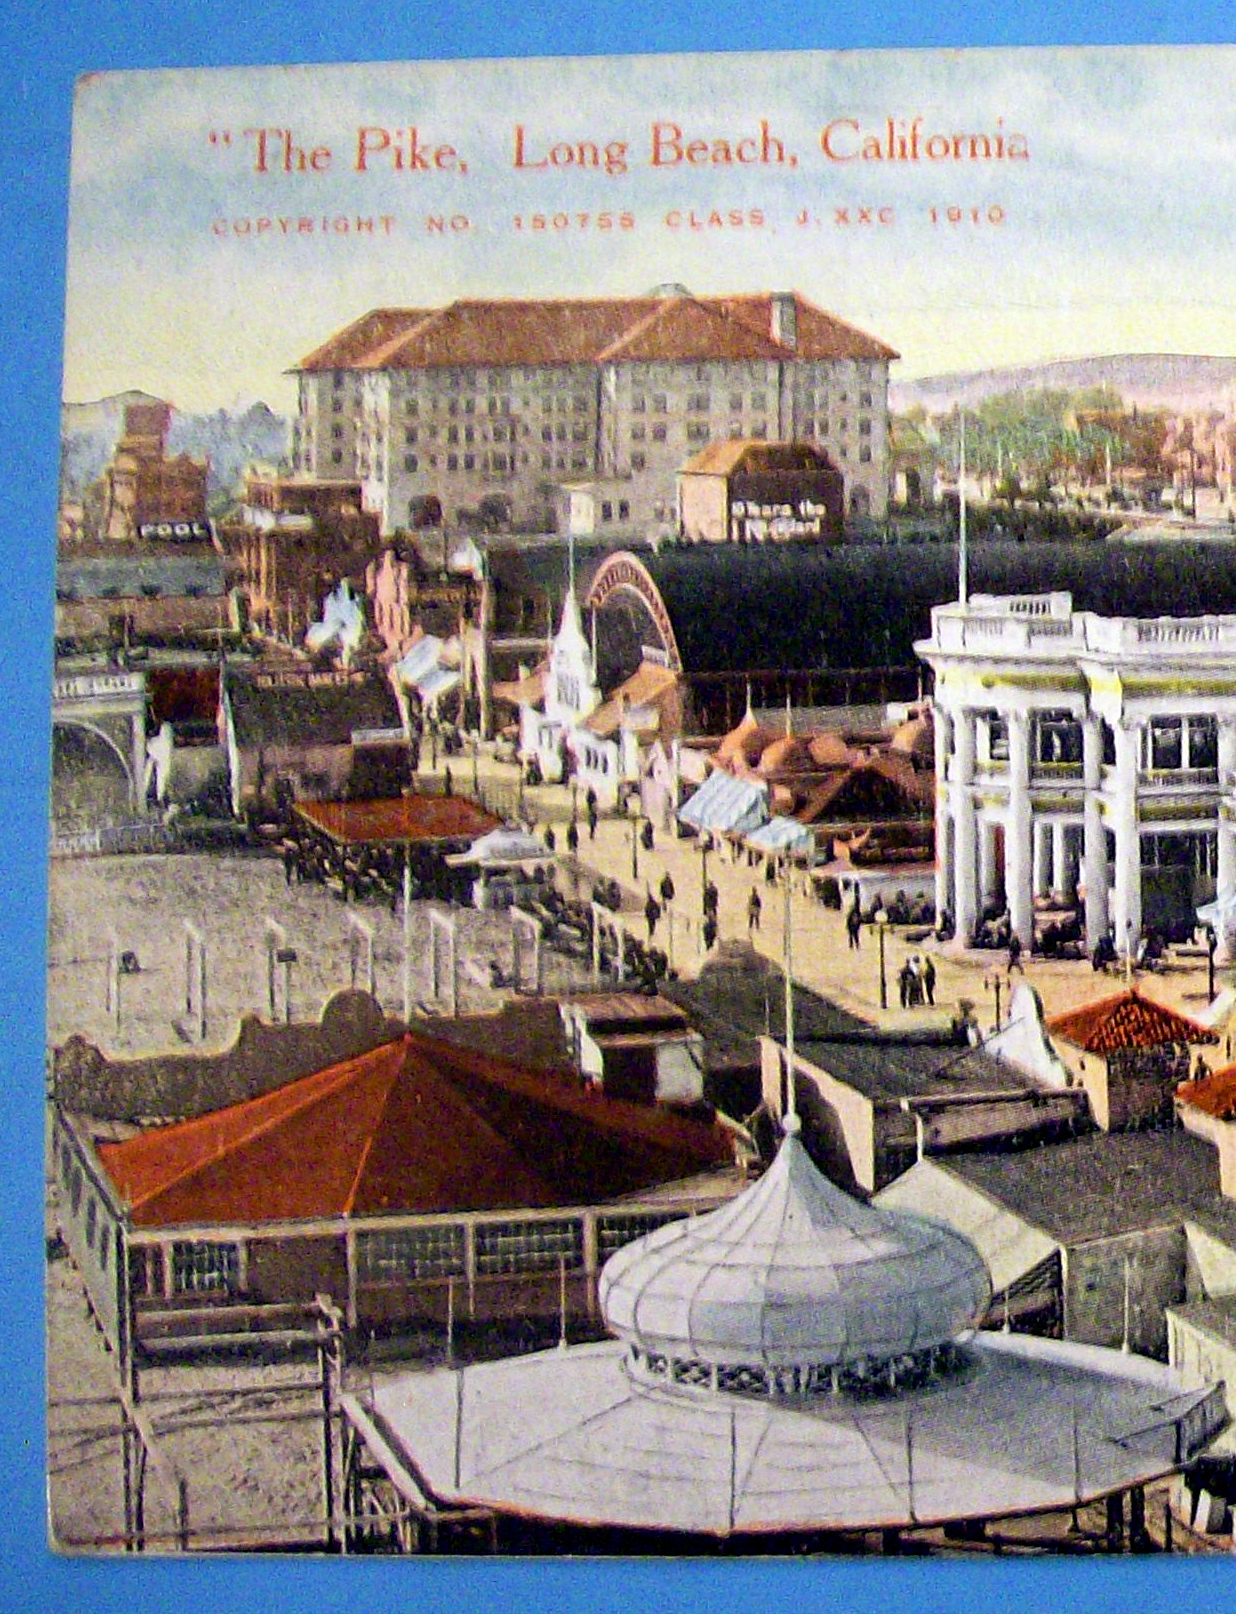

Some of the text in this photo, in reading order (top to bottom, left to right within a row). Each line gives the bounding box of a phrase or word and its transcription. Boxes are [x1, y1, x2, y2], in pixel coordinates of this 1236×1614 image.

[352, 125, 469, 175] Pike,
[512, 122, 630, 176] Long
[649, 117, 799, 170] Beach,
[818, 115, 1031, 164] California
[211, 213, 397, 237] COPYRIGHT
[662, 208, 766, 233] CLASS
[927, 203, 1007, 230] 1910
[140, 522, 206, 539] POOL
